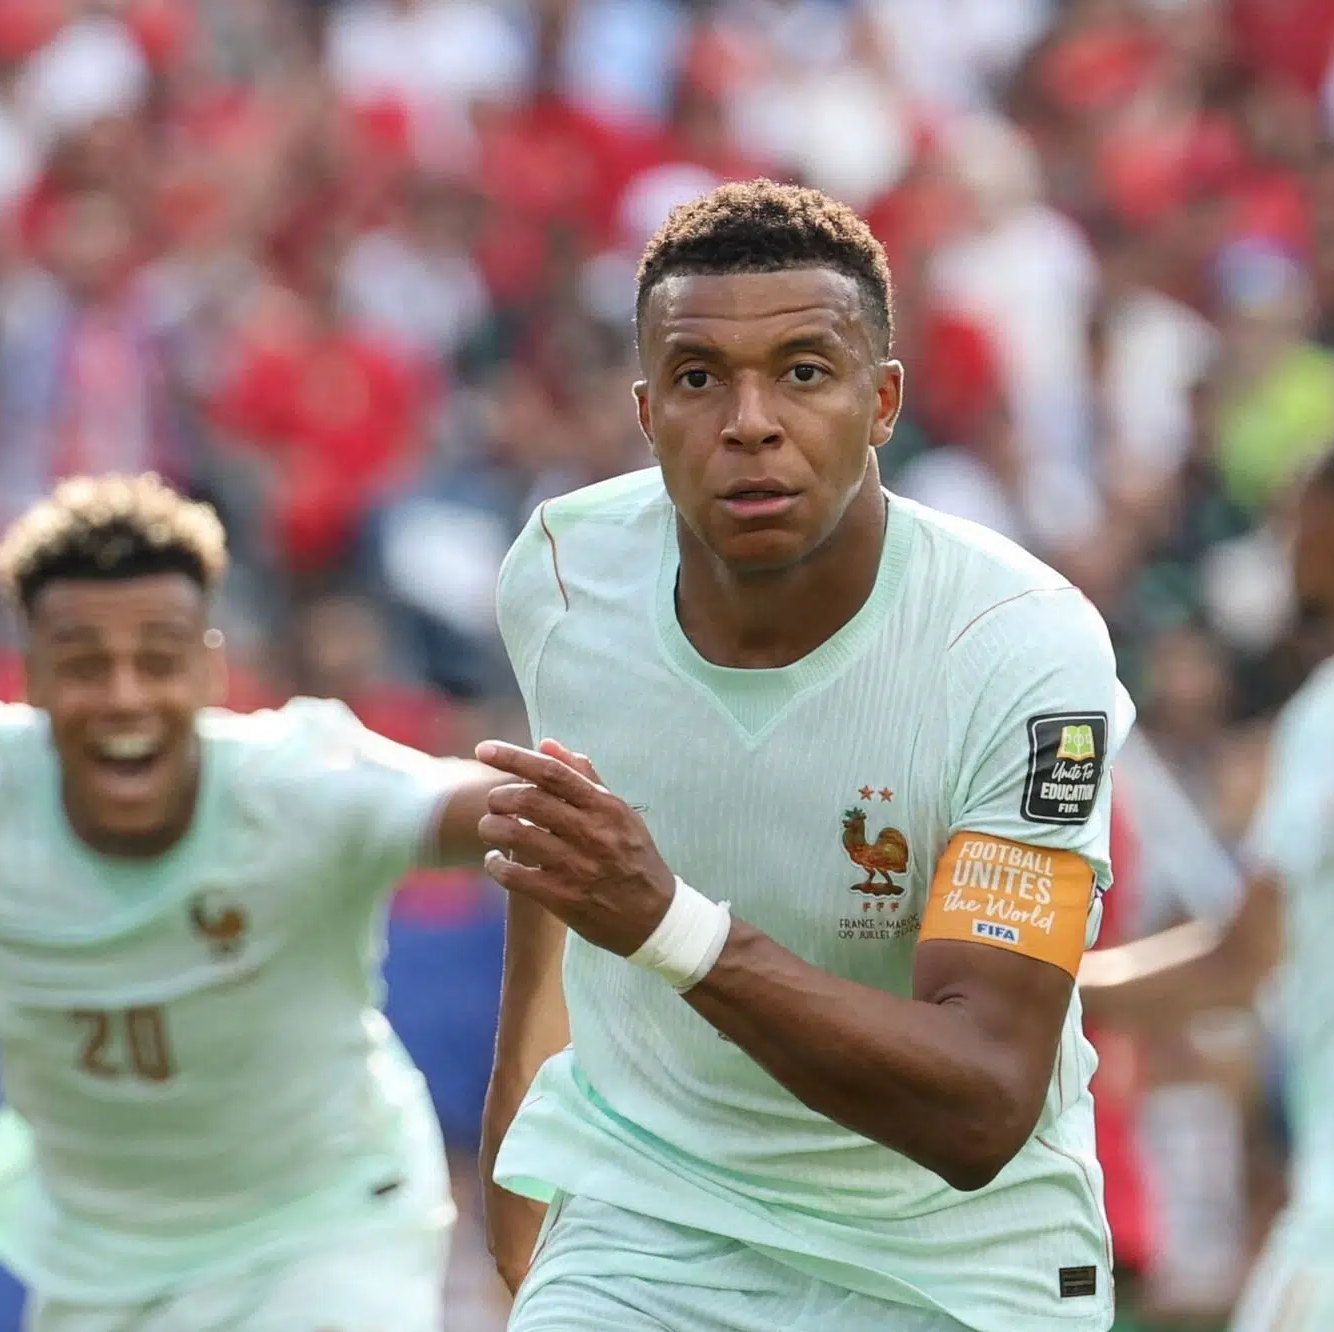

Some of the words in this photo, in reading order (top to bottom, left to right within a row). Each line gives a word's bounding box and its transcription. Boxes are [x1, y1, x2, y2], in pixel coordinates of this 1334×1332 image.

[1051, 761, 1082, 782] Unite
[1040, 782, 1096, 801] EDUCATION
[1058, 803, 1080, 813] FIFA
[959, 840, 1054, 877] FOOTBALL
[952, 859, 1052, 905] UNITES
[943, 888, 982, 912] the
[984, 893, 1056, 935] World
[839, 918, 875, 929] FRANCE
[976, 922, 1016, 941] FIFA
[838, 930, 855, 939] 09
[71, 1006, 177, 1081] 20
